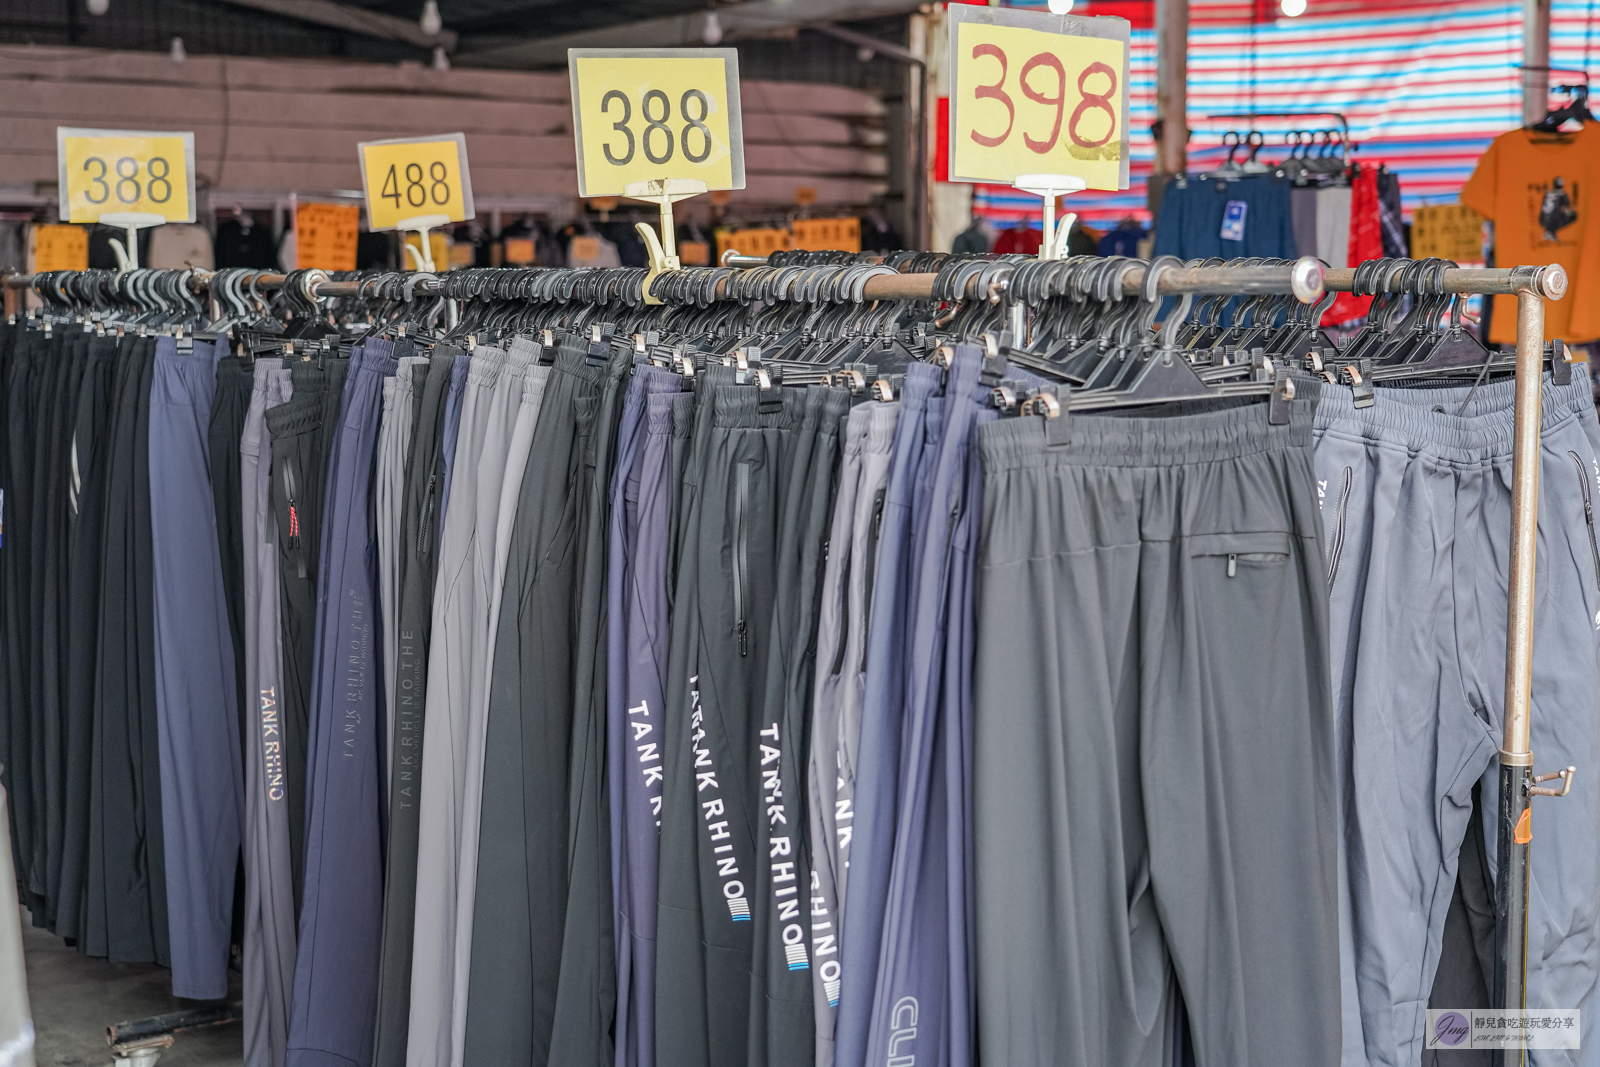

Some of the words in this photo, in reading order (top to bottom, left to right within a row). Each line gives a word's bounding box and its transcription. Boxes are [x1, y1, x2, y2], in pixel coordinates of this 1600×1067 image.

[599, 88, 713, 166] 388
[970, 43, 1117, 155] 398
[83, 156, 172, 205] 388
[380, 160, 451, 209] 488
[402, 630, 413, 670] THE
[260, 686, 279, 737] TANK
[401, 678, 413, 747] RHINO
[628, 700, 663, 787] TANK
[264, 741, 284, 801] RHINO
[400, 755, 413, 810] TANK
[702, 798, 745, 899] RHINO
[769, 836, 804, 945] RHINO
